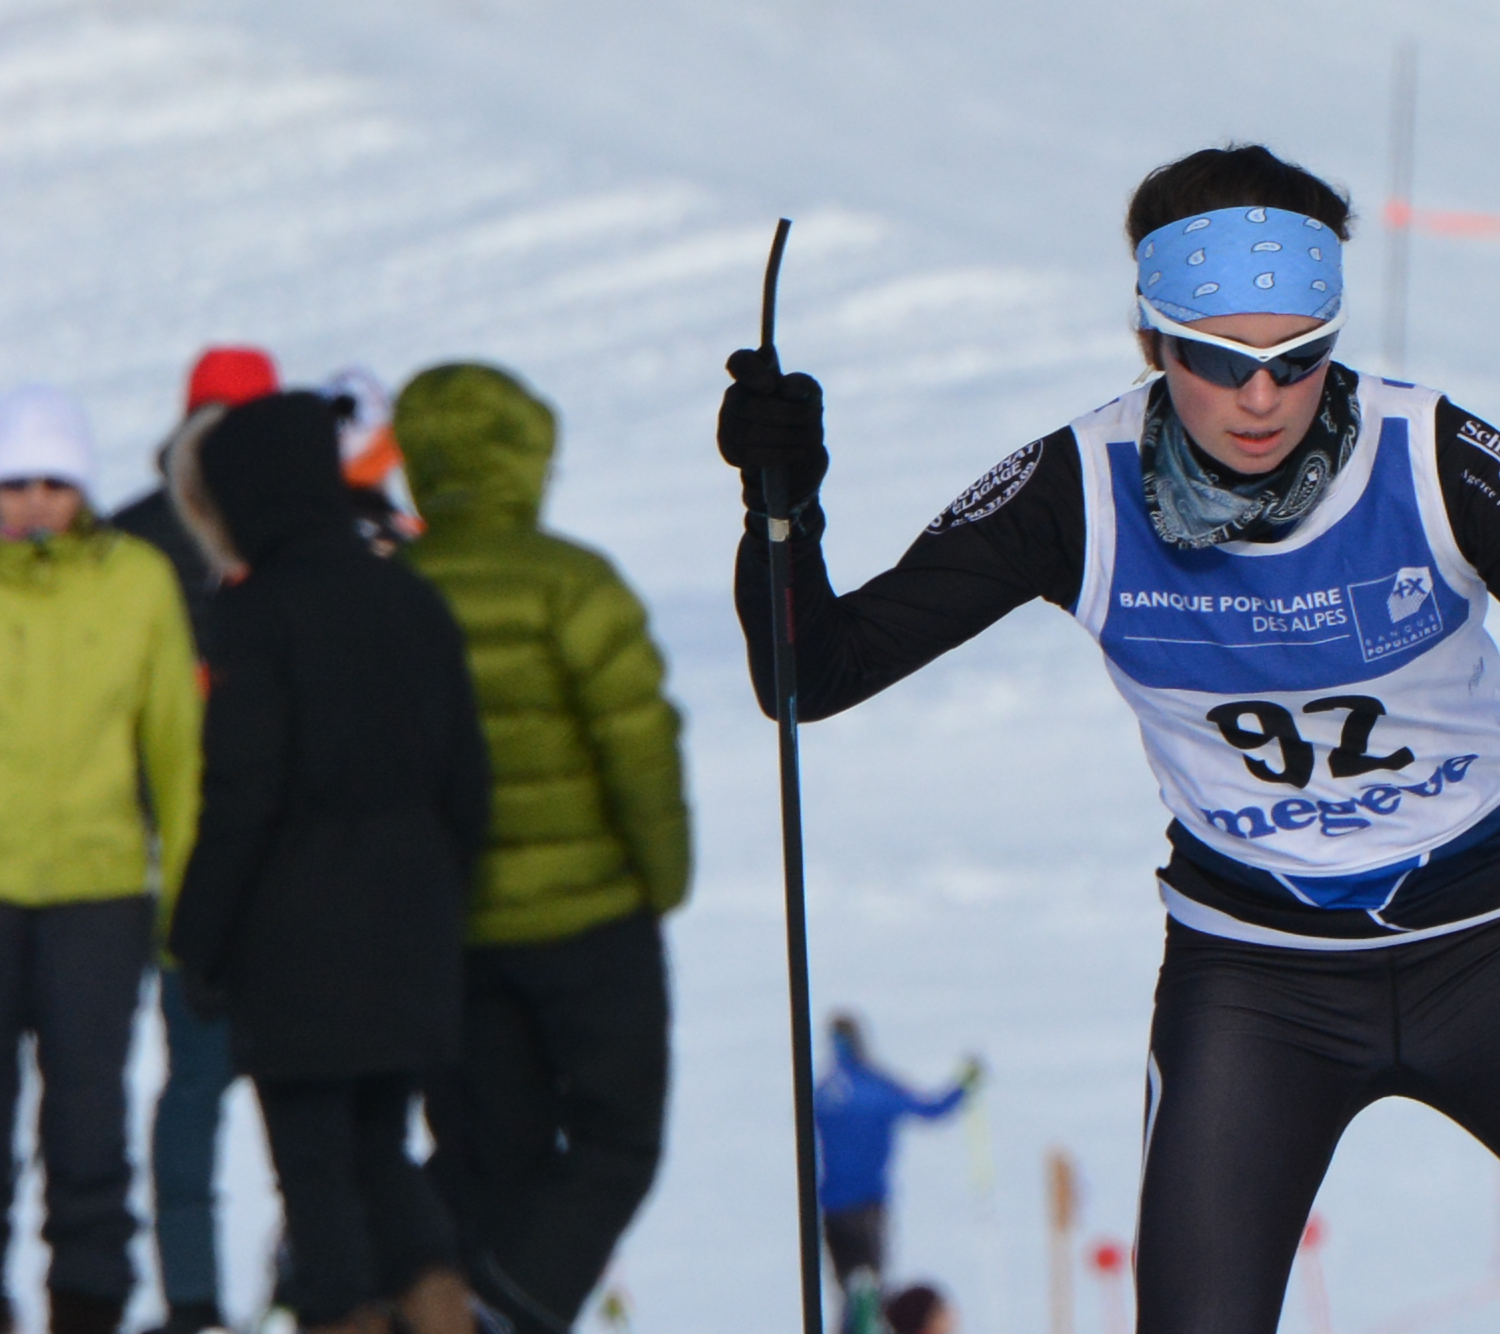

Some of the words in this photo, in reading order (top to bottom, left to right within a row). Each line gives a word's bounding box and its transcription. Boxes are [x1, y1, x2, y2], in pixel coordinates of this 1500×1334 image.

[1119, 591, 1214, 613] BANQUE
[1219, 588, 1342, 614] POPULAIRE
[1252, 616, 1288, 634] DES
[1290, 608, 1348, 633] ALPES
[1366, 623, 1440, 657] POPULAIRE
[1206, 694, 1415, 790] 92
